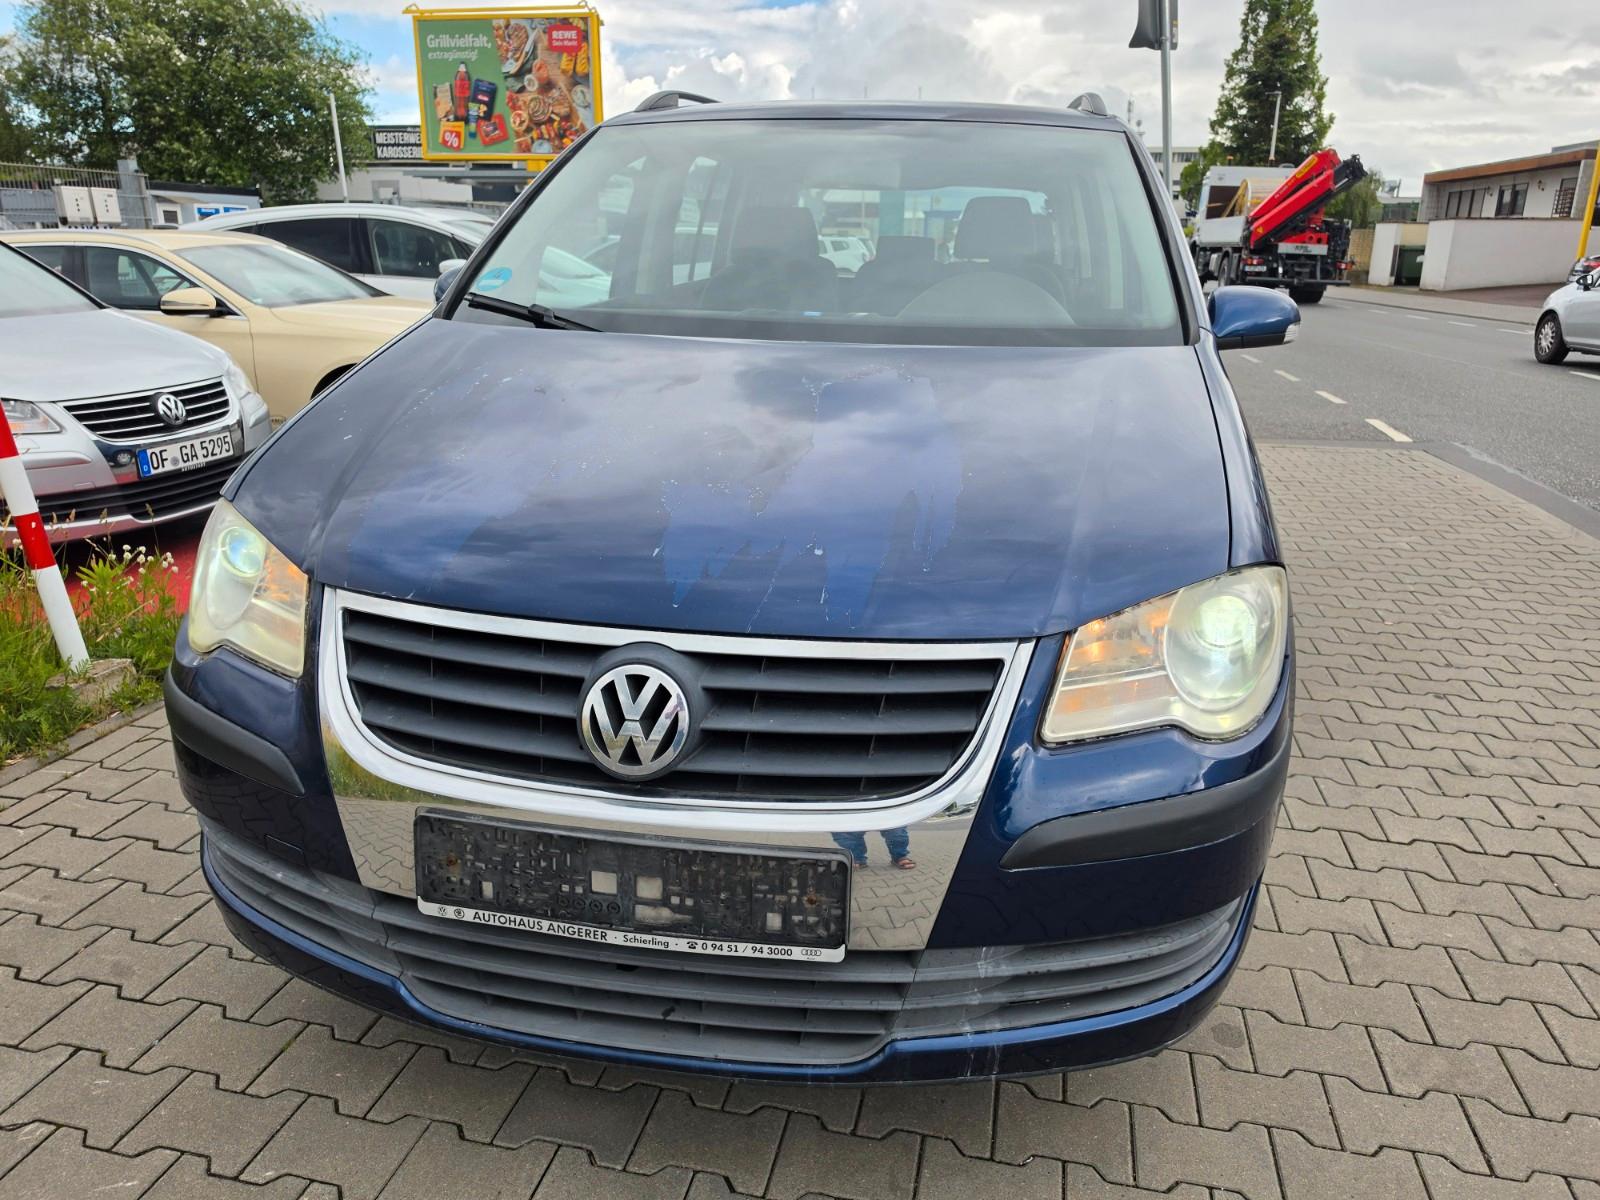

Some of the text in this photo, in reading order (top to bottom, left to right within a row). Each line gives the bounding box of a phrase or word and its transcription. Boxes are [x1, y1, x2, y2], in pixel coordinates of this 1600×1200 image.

[426, 33, 492, 49] Grillvielfalt,
[551, 30, 577, 40] REWE
[444, 131, 459, 148] %
[158, 393, 186, 425] VW
[149, 449, 169, 470] OF
[179, 443, 199, 463] GA
[200, 435, 231, 458] 5295
[582, 664, 690, 776] VW
[472, 911, 543, 932] AUTOHAUS
[547, 922, 608, 942] ANGERER
[623, 934, 670, 949] Schierling
[701, 942, 708, 951] 0
[710, 943, 724, 952] 94
[727, 944, 739, 953] 51
[751, 946, 764, 955] 94
[767, 947, 793, 957] 3000
